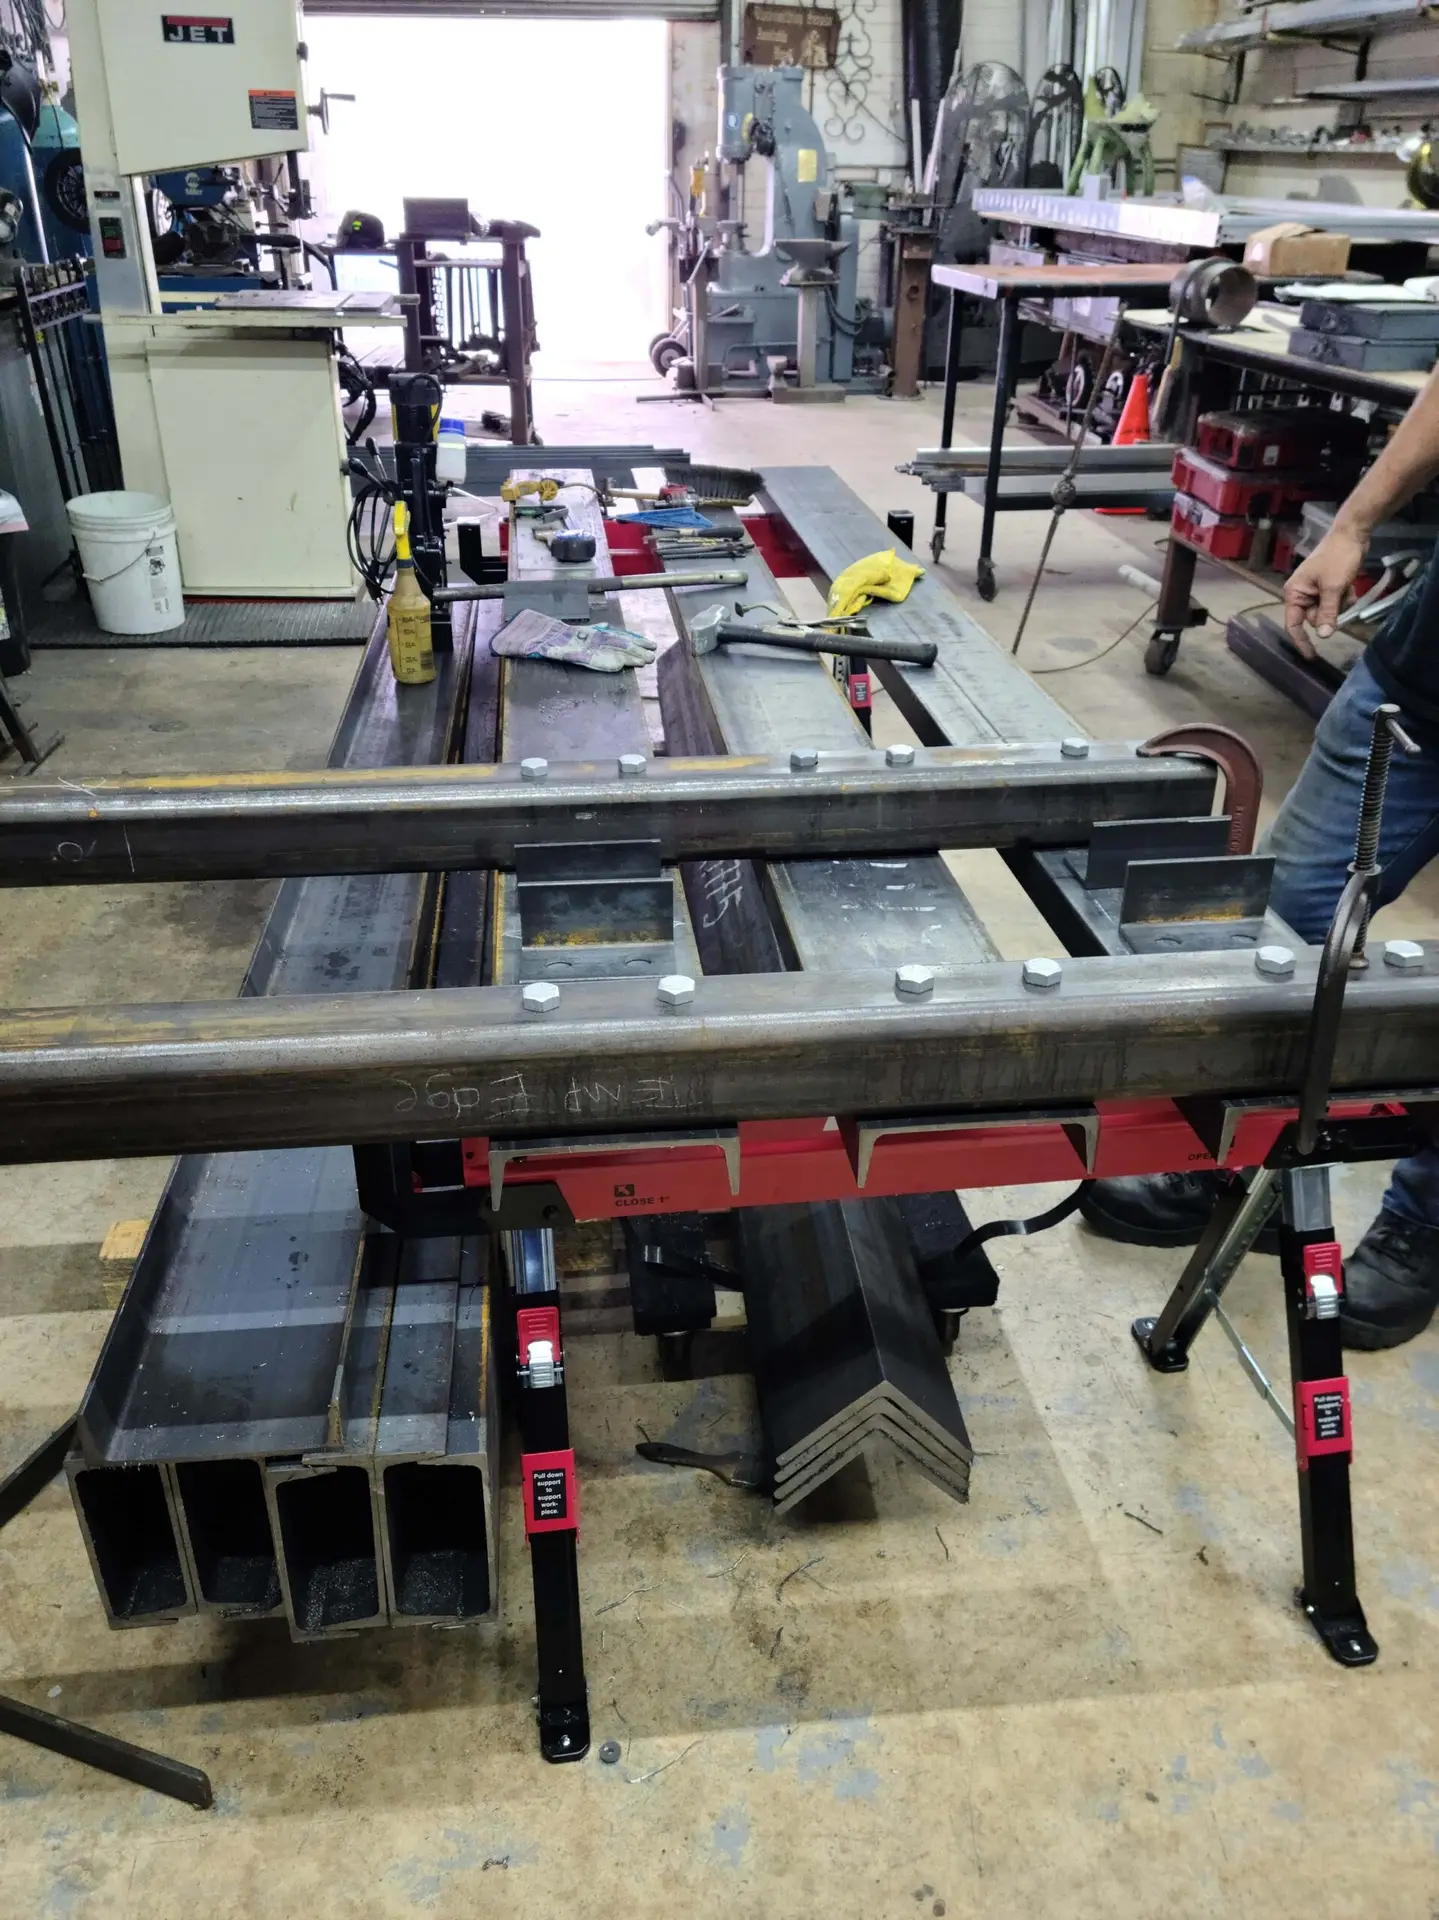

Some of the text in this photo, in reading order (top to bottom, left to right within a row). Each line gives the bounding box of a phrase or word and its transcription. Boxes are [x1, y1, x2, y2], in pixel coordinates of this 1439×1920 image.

[169, 26, 228, 42] JET
[395, 1071, 540, 1120] Edge
[615, 1197, 655, 1207] CLOSE
[541, 1508, 559, 1516] piece.
